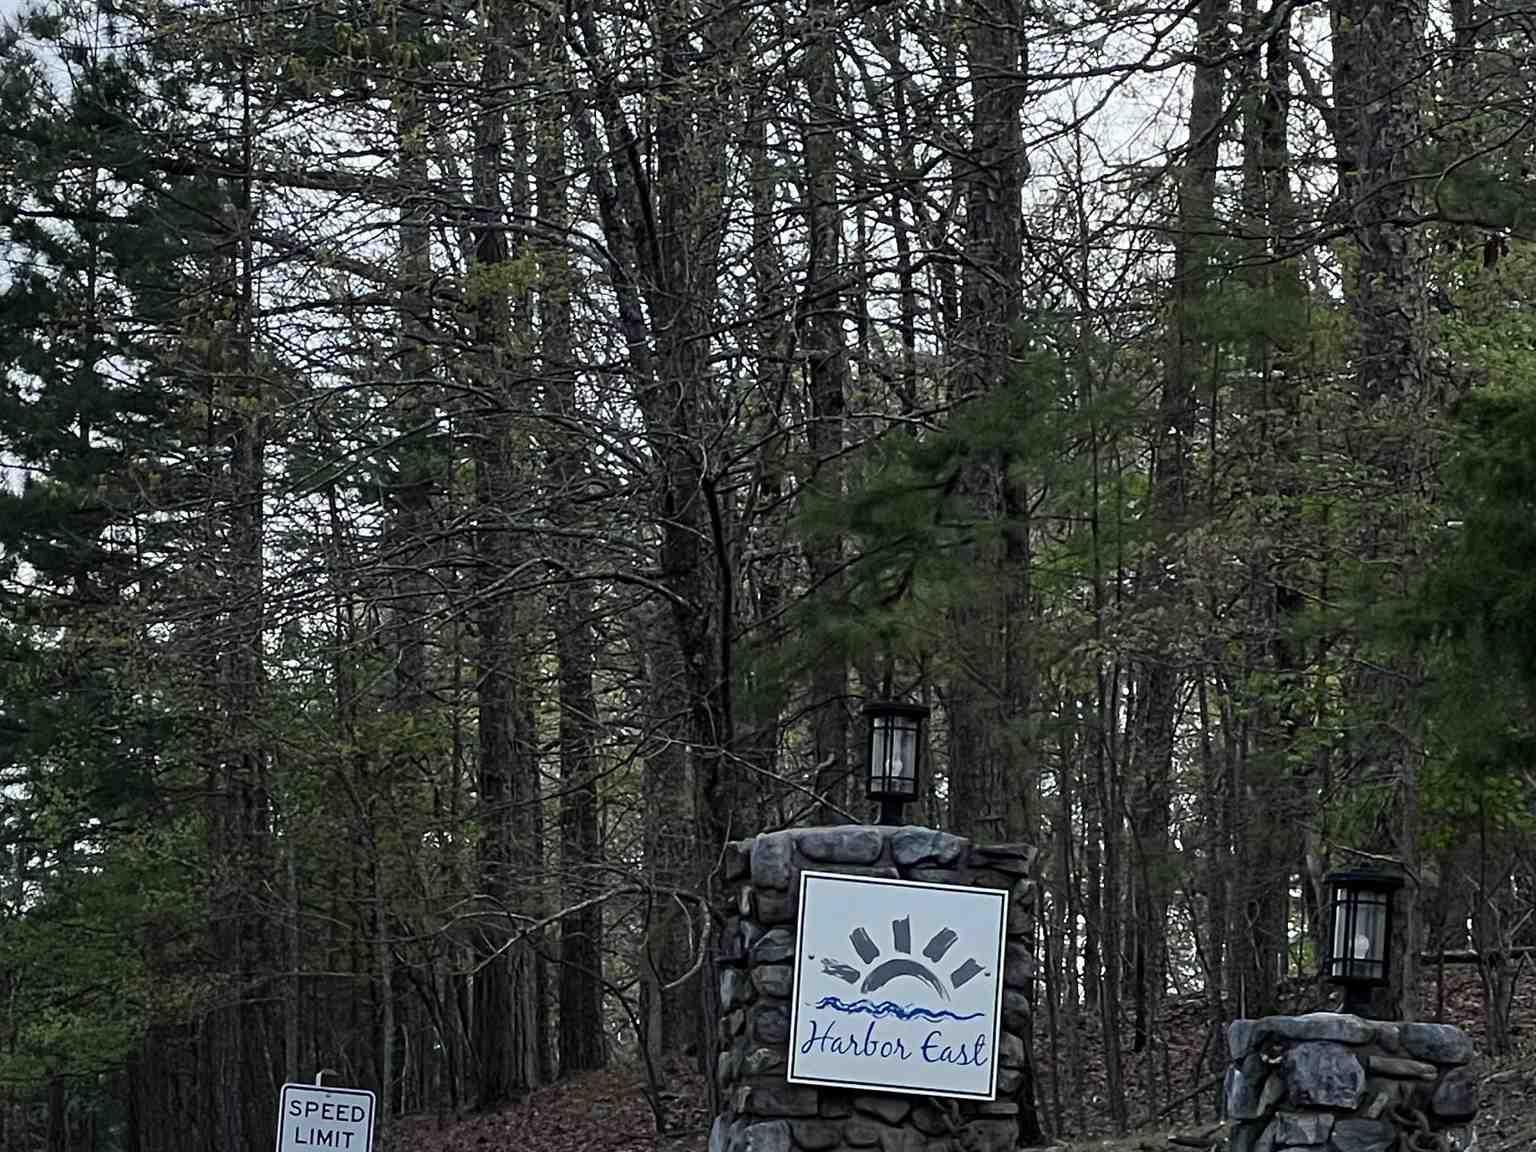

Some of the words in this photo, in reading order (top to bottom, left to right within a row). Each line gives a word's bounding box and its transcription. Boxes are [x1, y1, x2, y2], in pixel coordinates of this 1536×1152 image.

[801, 1020, 913, 1061] Harbor
[920, 1030, 988, 1066] East
[289, 1100, 365, 1123] SPEED
[295, 1126, 355, 1149] LIMIT
